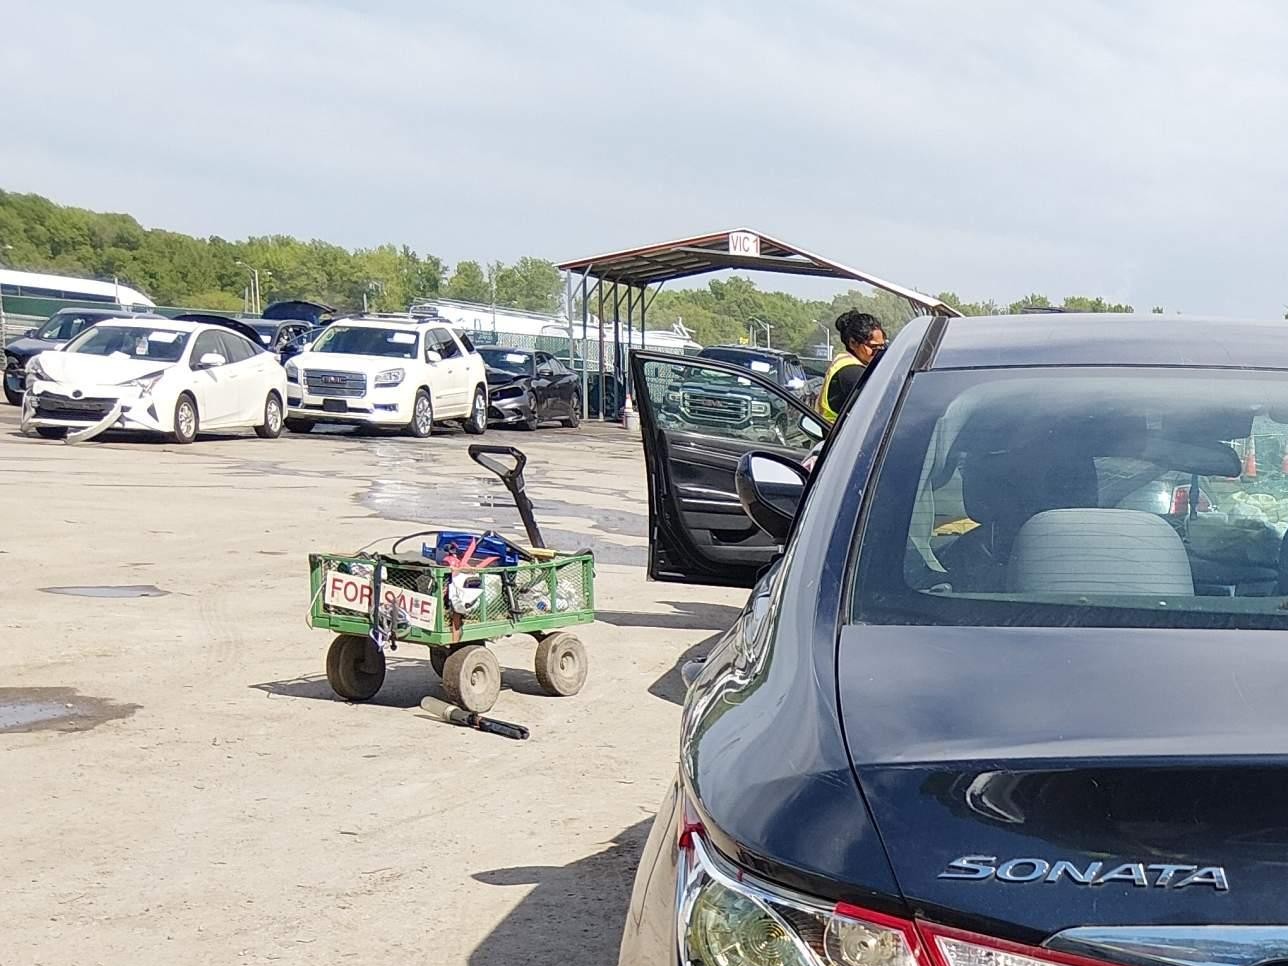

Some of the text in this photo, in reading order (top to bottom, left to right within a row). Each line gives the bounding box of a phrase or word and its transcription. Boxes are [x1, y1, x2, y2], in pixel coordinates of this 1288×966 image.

[731, 235, 759, 253] VIC 1
[332, 577, 374, 606] FOR
[937, 855, 1229, 891] SONATA
